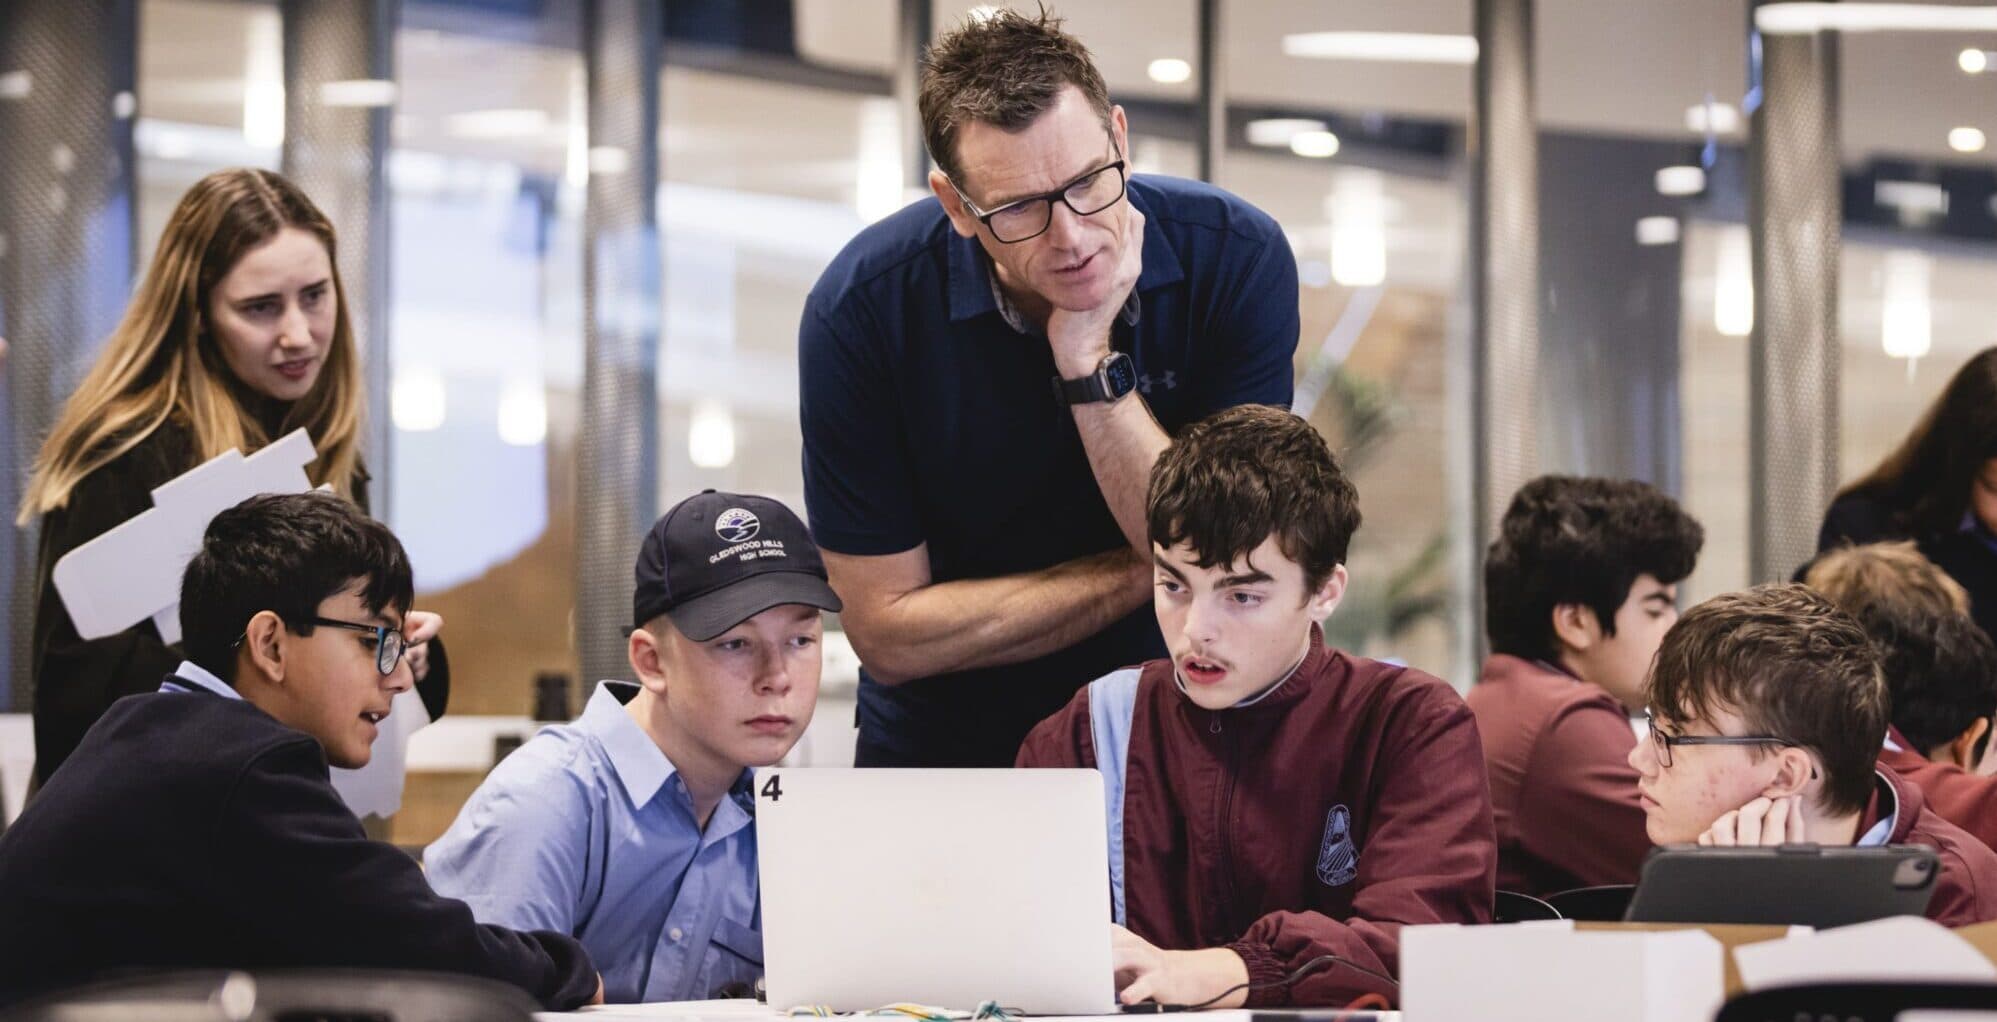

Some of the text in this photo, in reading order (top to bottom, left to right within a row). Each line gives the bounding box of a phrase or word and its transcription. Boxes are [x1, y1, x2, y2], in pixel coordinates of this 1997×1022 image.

[709, 540, 784, 564] GLEDSWOOD HILLS
[739, 549, 787, 561] HIGH SCHOOL
[761, 774, 783, 801] 4
